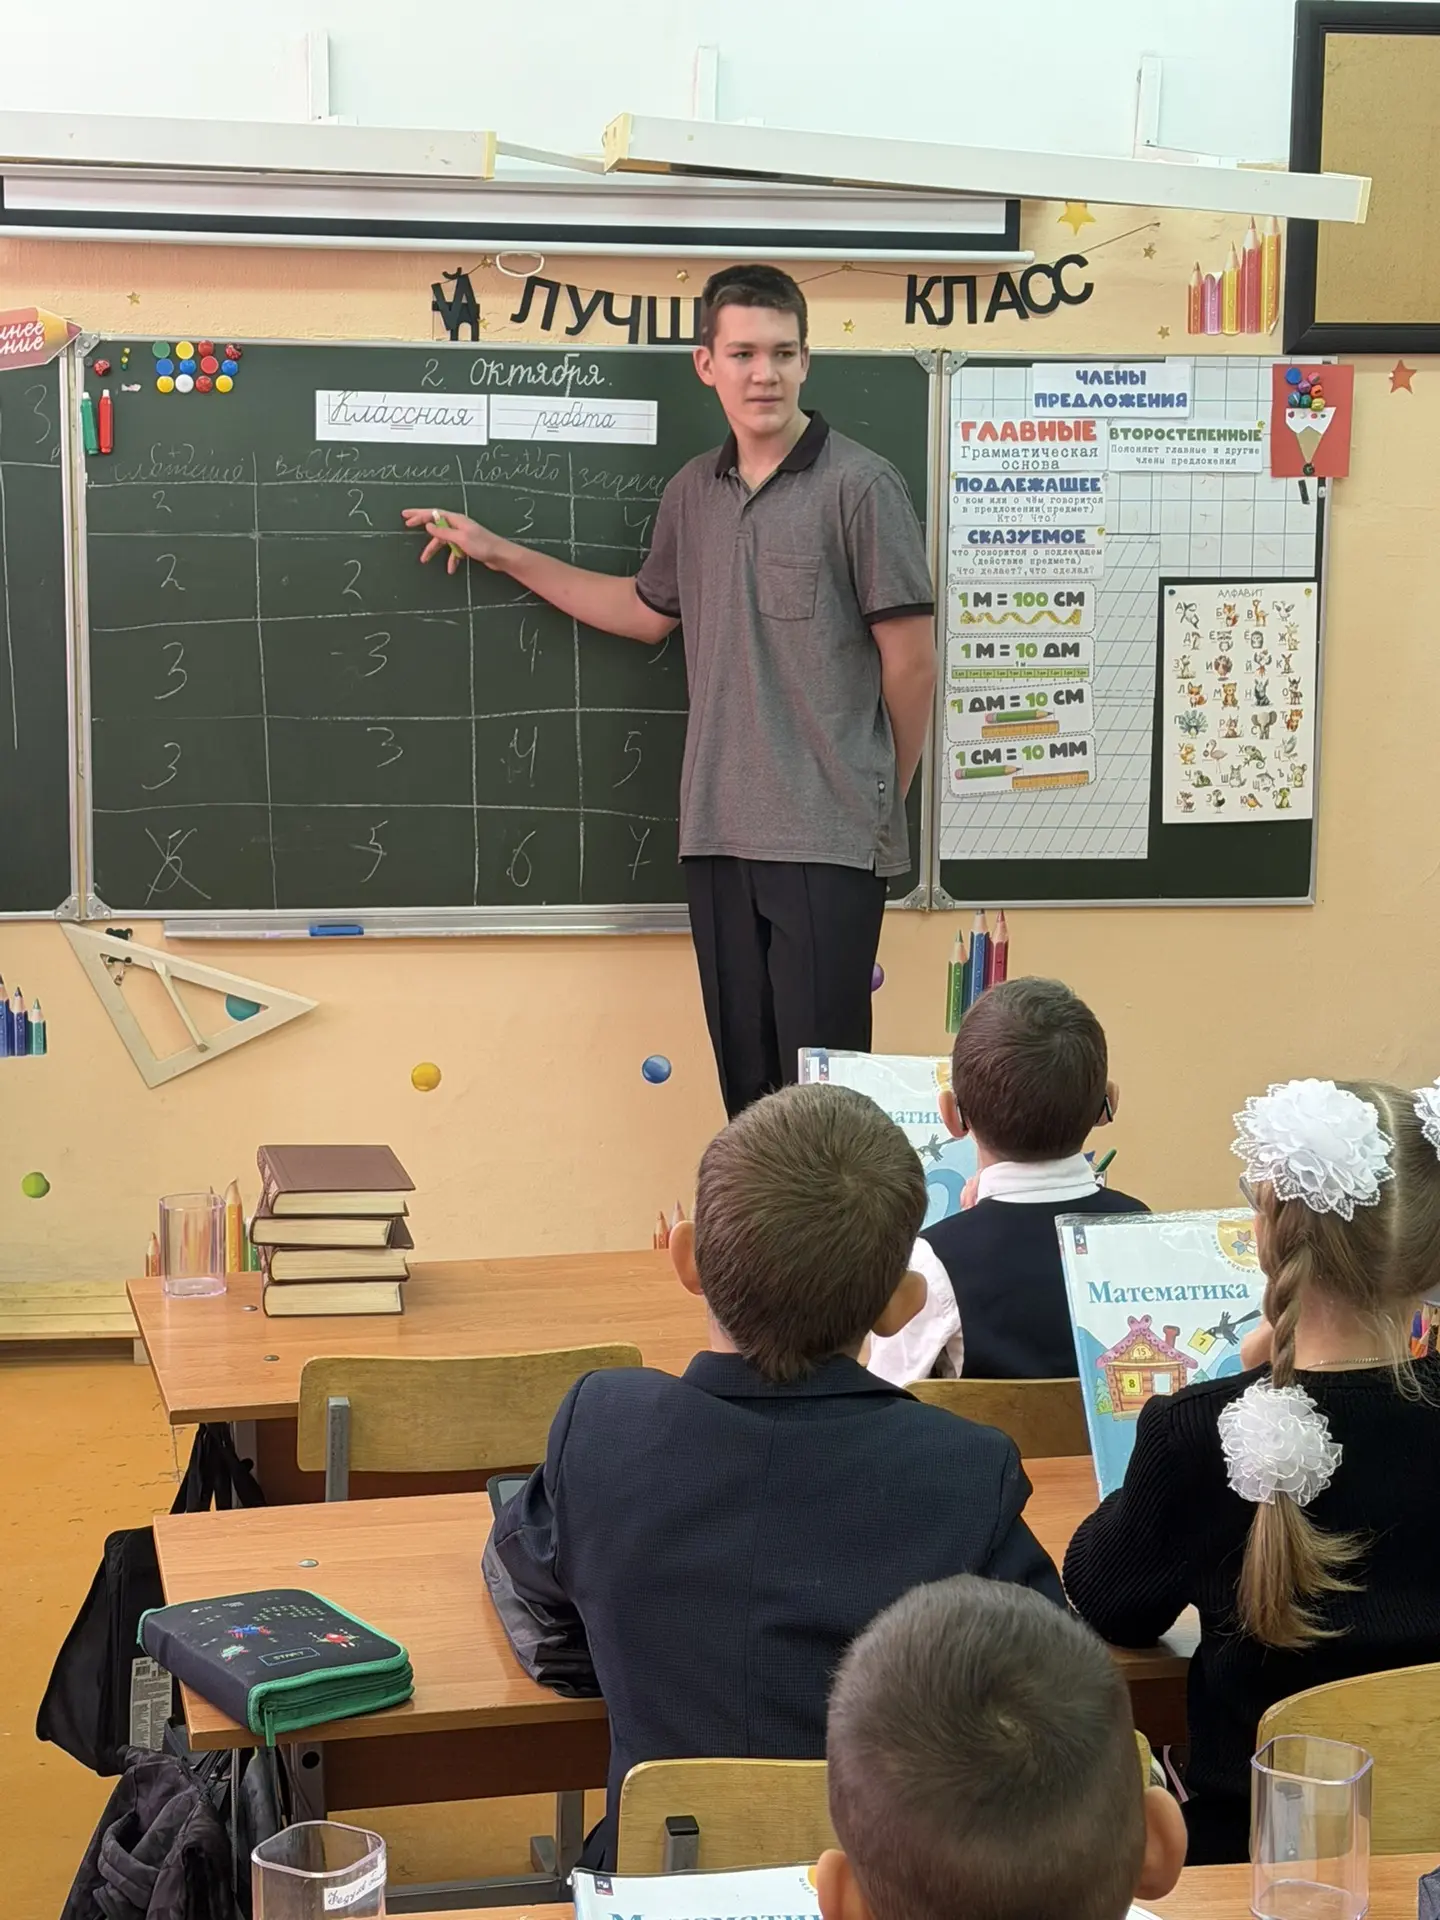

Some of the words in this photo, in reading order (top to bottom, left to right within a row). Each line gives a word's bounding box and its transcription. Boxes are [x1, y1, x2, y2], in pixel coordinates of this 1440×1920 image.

[905, 253, 1094, 326] КЛАСС
[1075, 370, 1146, 386] ЧЛЕНЫ
[1034, 392, 1188, 408] ПРЕДЛОЖЕНИЯ
[331, 391, 474, 426] Классная
[531, 401, 616, 438] работа
[960, 420, 1098, 442] ГЛАВНЫЕ
[1109, 428, 1262, 442] ВТОРОСТЕПЕННЫЕ
[961, 446, 1099, 460] Грамматическая
[1111, 444, 1159, 454] Поясняют
[1166, 446, 1207, 455] главные
[1225, 447, 1260, 456] другие
[1001, 459, 1060, 470] основа
[1136, 457, 1165, 465] члены
[1171, 458, 1237, 466] предложения
[152, 490, 172, 513] 2
[347, 488, 373, 527] 2
[1026, 496, 1044, 504] чём
[1050, 497, 1104, 505] говорится
[514, 496, 536, 534] 3
[997, 514, 1023, 523] Кто?
[1032, 514, 1057, 523] Что?
[967, 529, 1086, 544] СКАЗУЕМОЕ
[972, 555, 1024, 566] (действие
[1030, 555, 1081, 566] предмета)
[156, 553, 186, 591] 2
[956, 567, 975, 575] Что
[342, 559, 363, 600] 2
[958, 592, 969, 608] 1
[973, 592, 992, 607] М
[1012, 591, 1049, 607] 100
[1054, 591, 1085, 607] СМ
[1217, 588, 1264, 598] АЛФАВИТ
[1216, 608, 1223, 616] Б
[1247, 610, 1254, 618] В
[1183, 633, 1191, 643] Д
[1278, 633, 1287, 641] Ж
[961, 643, 971, 658] 1
[976, 643, 995, 658] М
[1015, 643, 1038, 658] 10
[1043, 642, 1080, 658] ДМ
[154, 641, 188, 699] 3
[1206, 661, 1213, 670] И
[1276, 660, 1283, 668] К
[1177, 684, 1185, 694] Л
[1213, 689, 1222, 697] М
[1245, 689, 1252, 698] Н
[951, 699, 963, 713] 1
[969, 695, 1005, 712] ДМ
[1025, 692, 1048, 707] 10
[1053, 688, 1084, 705] СМ
[1219, 718, 1225, 728] Р
[367, 727, 403, 768] 3
[955, 751, 966, 766] 1
[971, 748, 1001, 765] СМ
[1021, 745, 1044, 760] 10
[1050, 741, 1087, 758] ММ
[1238, 744, 1245, 753] Х
[141, 742, 181, 790] 3
[612, 731, 643, 788] 5
[1185, 769, 1191, 778] Ч
[1221, 774, 1228, 783] Ш
[1087, 1280, 1250, 1304] Математика
[1199, 1337, 1206, 1346] 7
[1137, 1347, 1147, 1356] 15
[1128, 1378, 1136, 1389] 8
